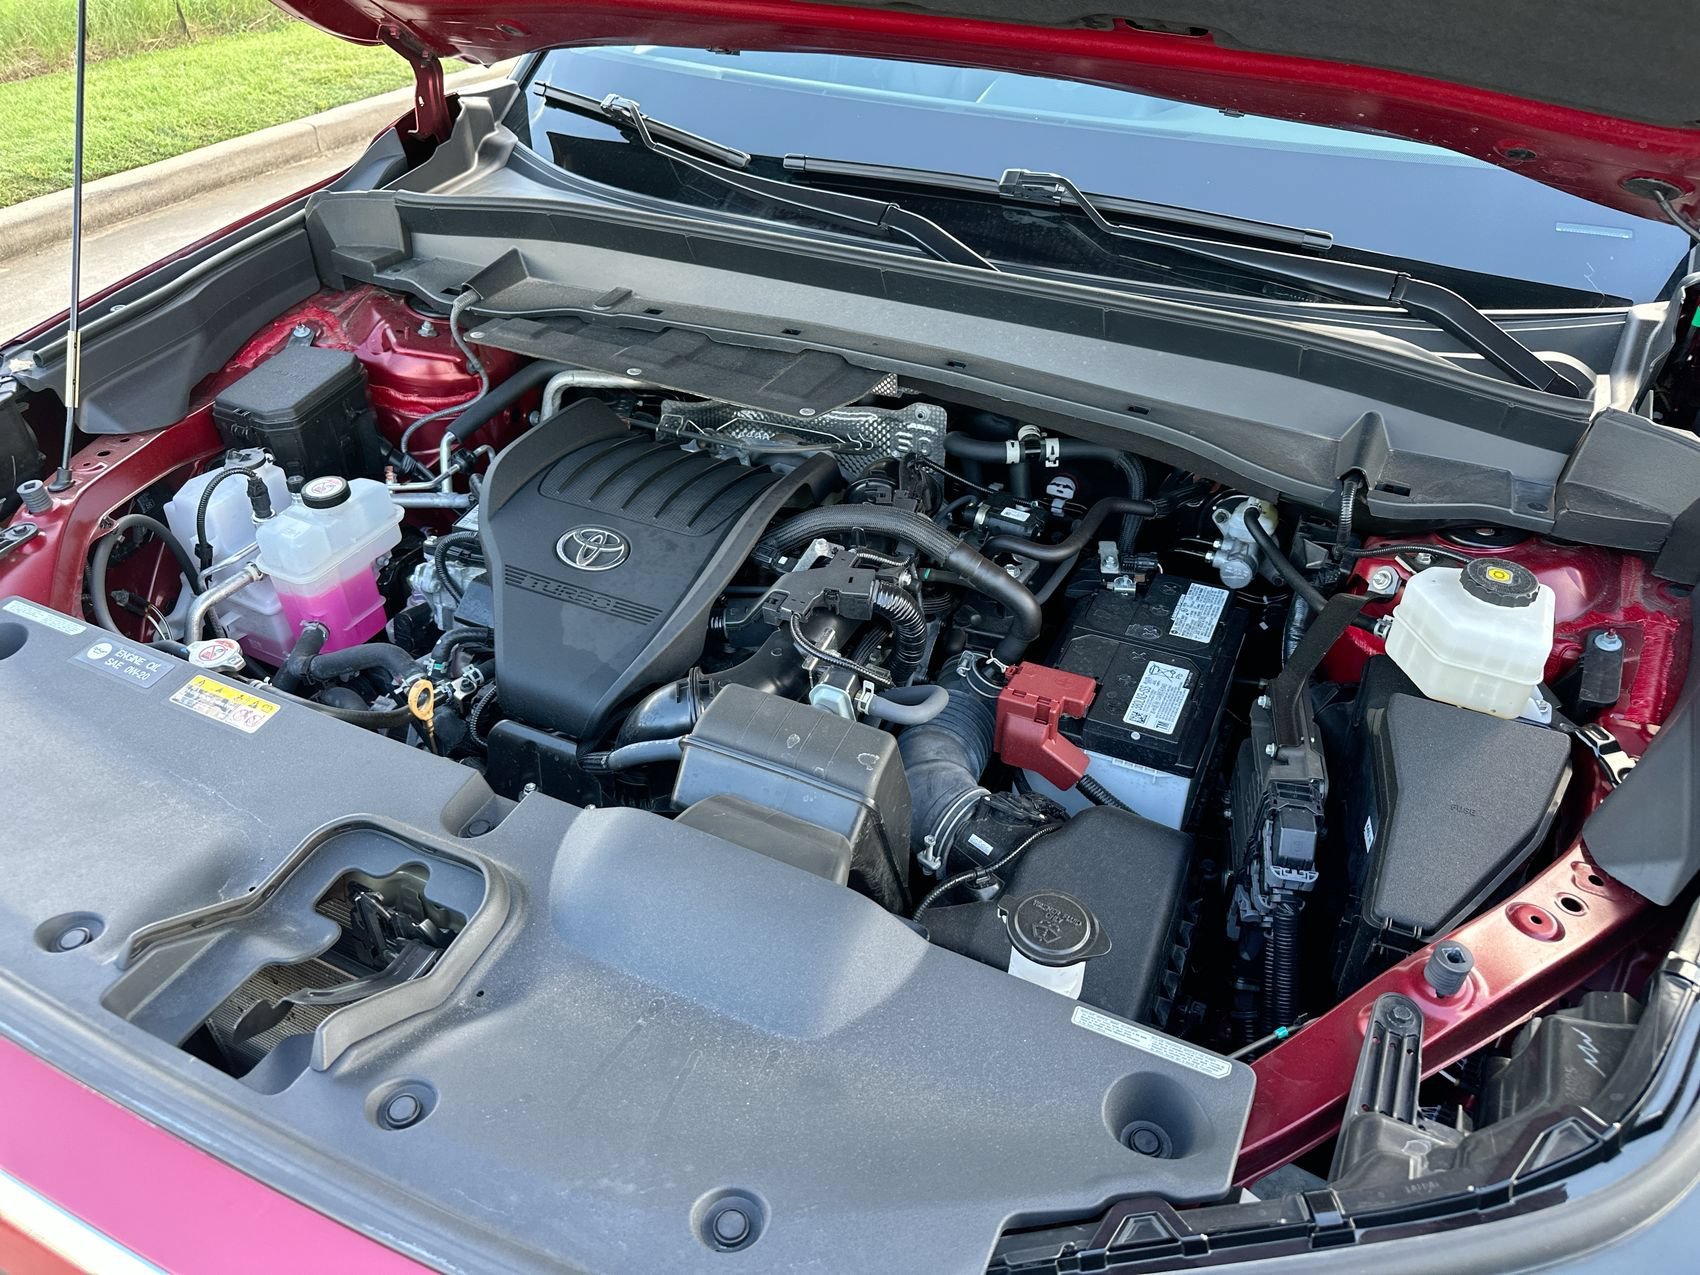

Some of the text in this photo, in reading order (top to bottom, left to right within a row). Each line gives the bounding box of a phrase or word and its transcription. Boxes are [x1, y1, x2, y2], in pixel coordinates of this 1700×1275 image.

[526, 575, 613, 609] TURBO
[104, 657, 125, 670] SAE
[114, 646, 147, 667] ENGINE
[145, 661, 162, 673] OIL
[1450, 804, 1476, 817] FUSE
